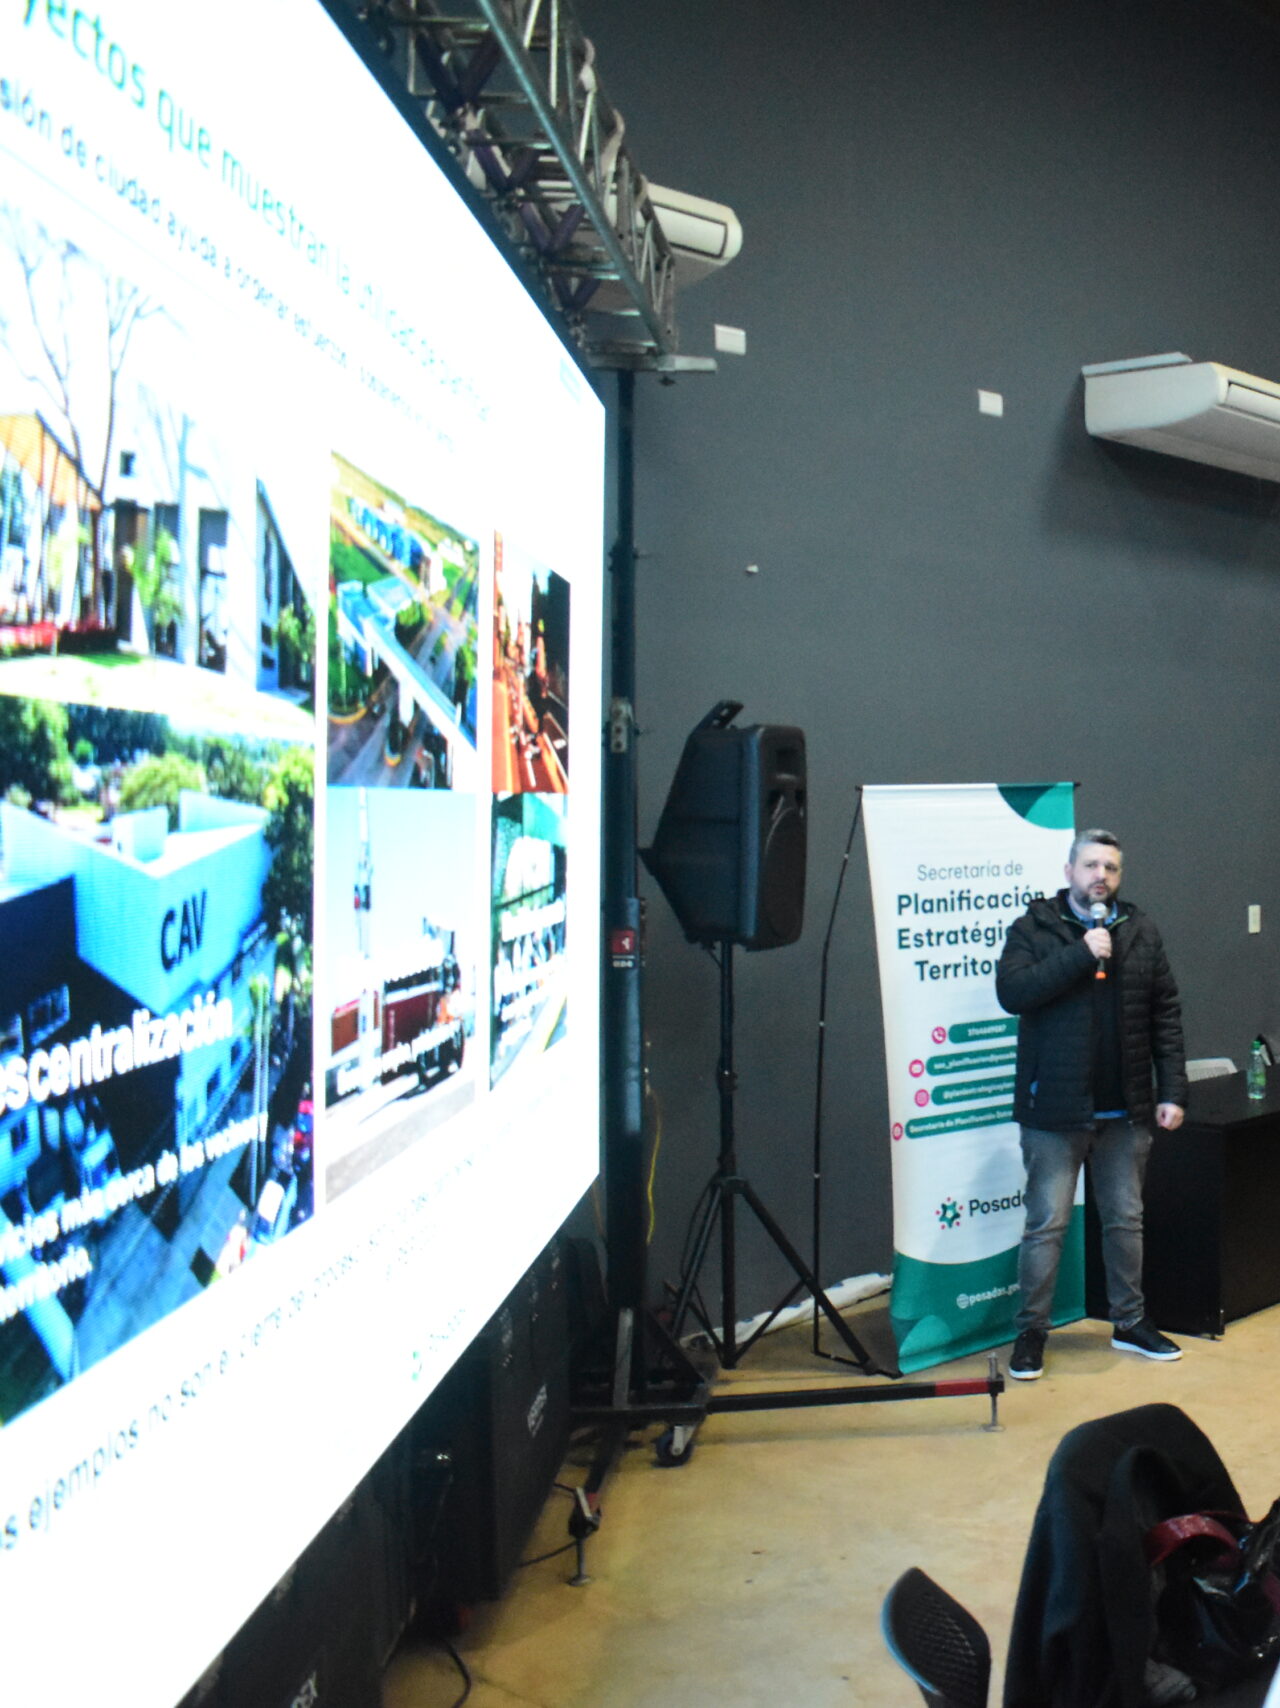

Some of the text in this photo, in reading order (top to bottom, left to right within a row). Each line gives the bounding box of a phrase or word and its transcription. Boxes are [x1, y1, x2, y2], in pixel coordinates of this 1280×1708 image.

[61, 124, 88, 169] de
[157, 87, 212, 170] que
[220, 147, 331, 277] muestran
[917, 860, 1023, 881] Secretaría de
[161, 888, 207, 973] CAV
[897, 919, 1009, 950] Estratégi
[28, 1417, 140, 1536] ejemplos
